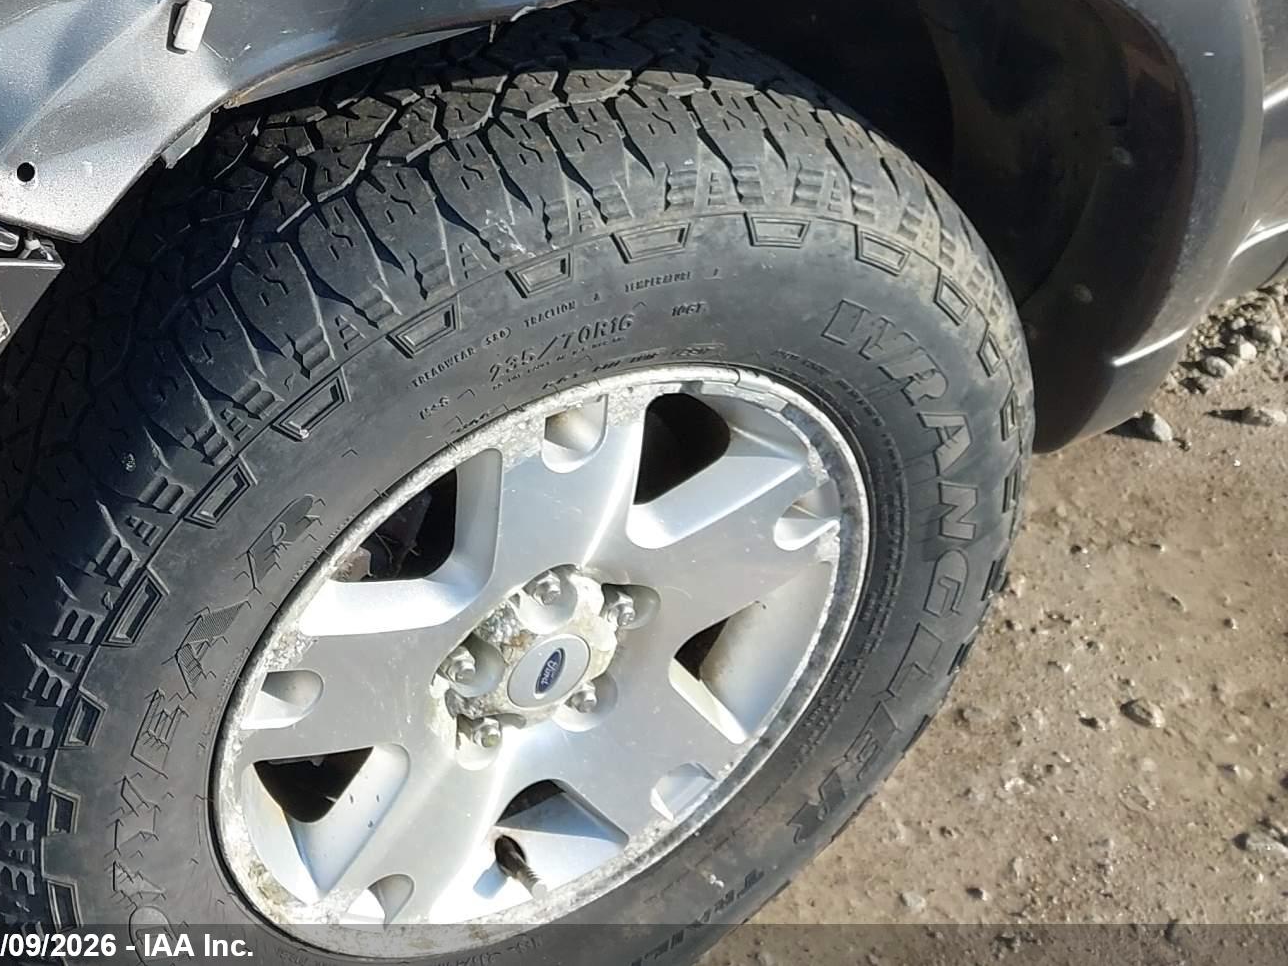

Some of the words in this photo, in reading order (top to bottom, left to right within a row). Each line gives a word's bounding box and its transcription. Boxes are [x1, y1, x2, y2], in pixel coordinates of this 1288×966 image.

[412, 346, 476, 387] TREADWEAR
[524, 300, 576, 327] TRACTION
[489, 313, 635, 382] 235/70R16
[786, 299, 978, 846] WRANGLER
